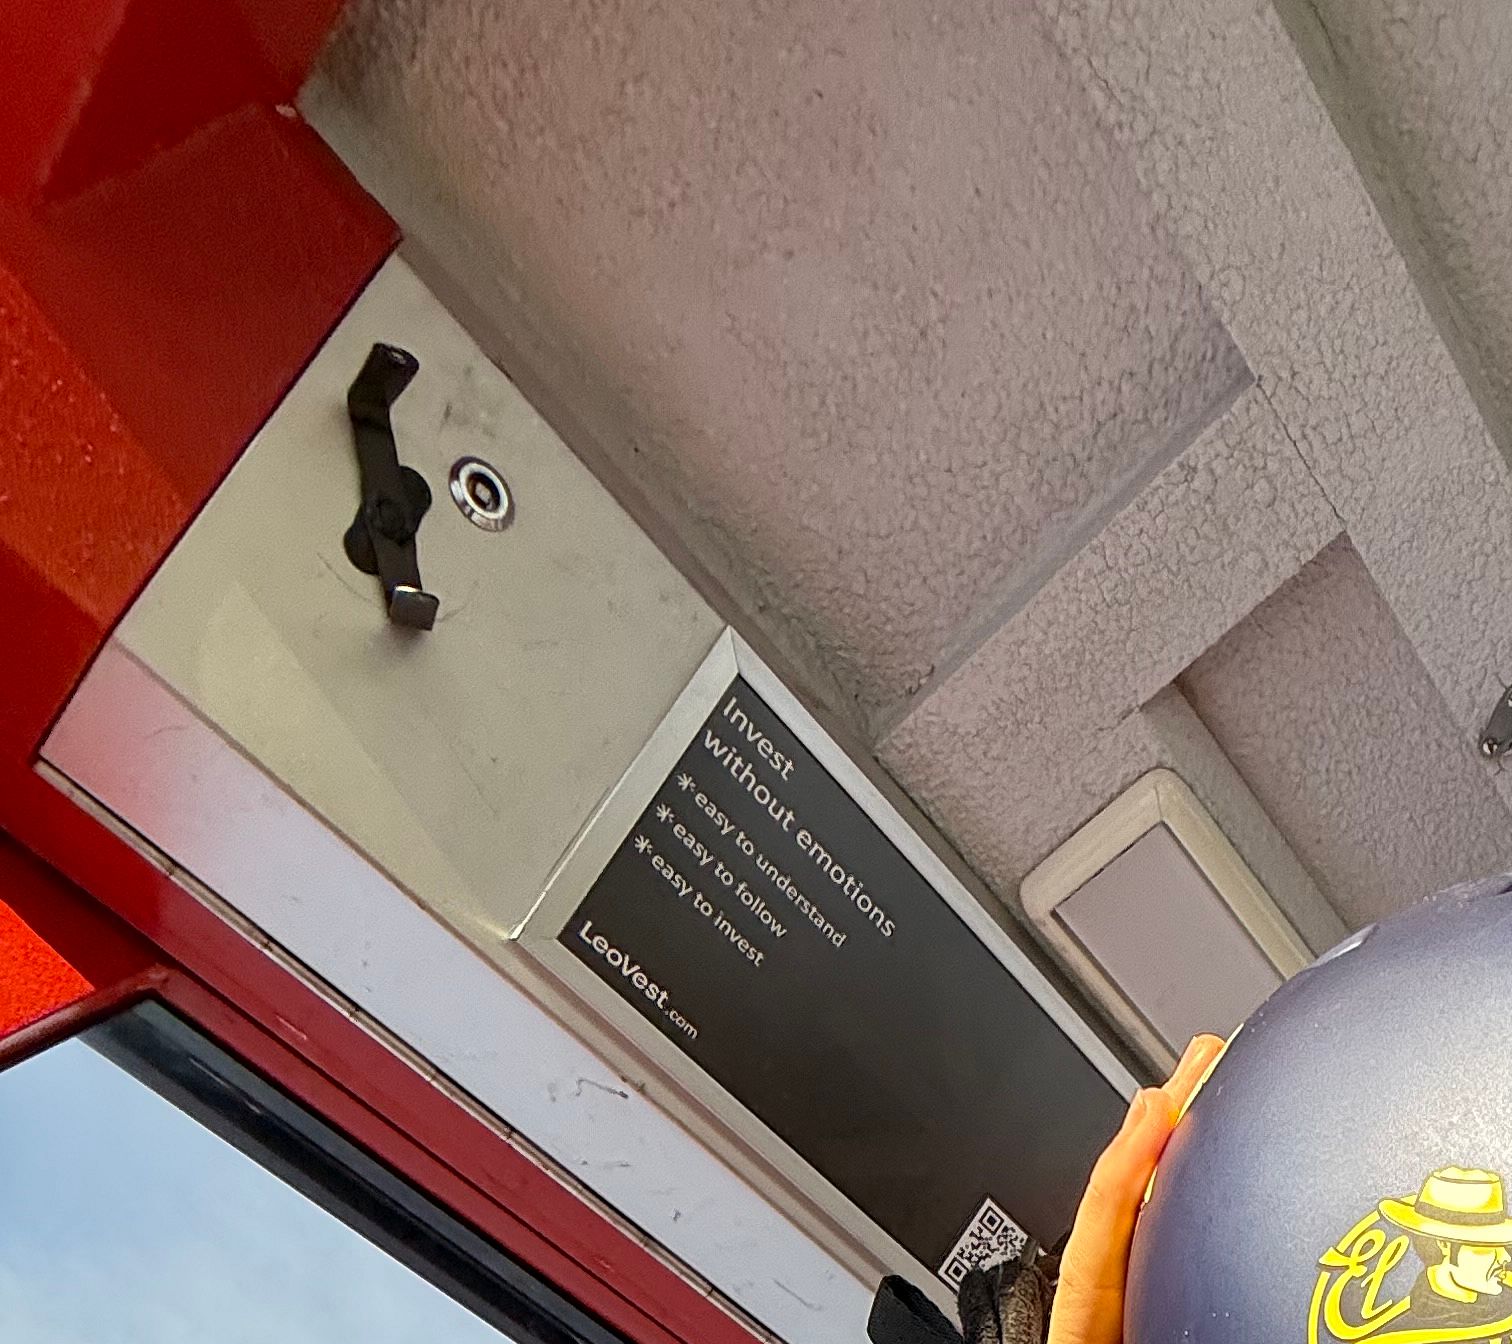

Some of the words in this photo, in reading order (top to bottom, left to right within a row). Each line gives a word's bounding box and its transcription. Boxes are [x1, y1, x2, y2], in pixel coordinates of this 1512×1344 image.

[723, 697, 794, 781] Invest
[673, 823, 714, 866] easy
[714, 861, 733, 886] to
[735, 881, 787, 937] follow
[695, 792, 735, 835] easy
[735, 831, 754, 855] to
[756, 853, 847, 947] understand
[704, 730, 796, 832] without
[796, 828, 895, 937] emotions
[652, 855, 693, 897] easy
[694, 892, 713, 916] to
[714, 910, 764, 967] invest
[1319, 1229, 1411, 1340] El
